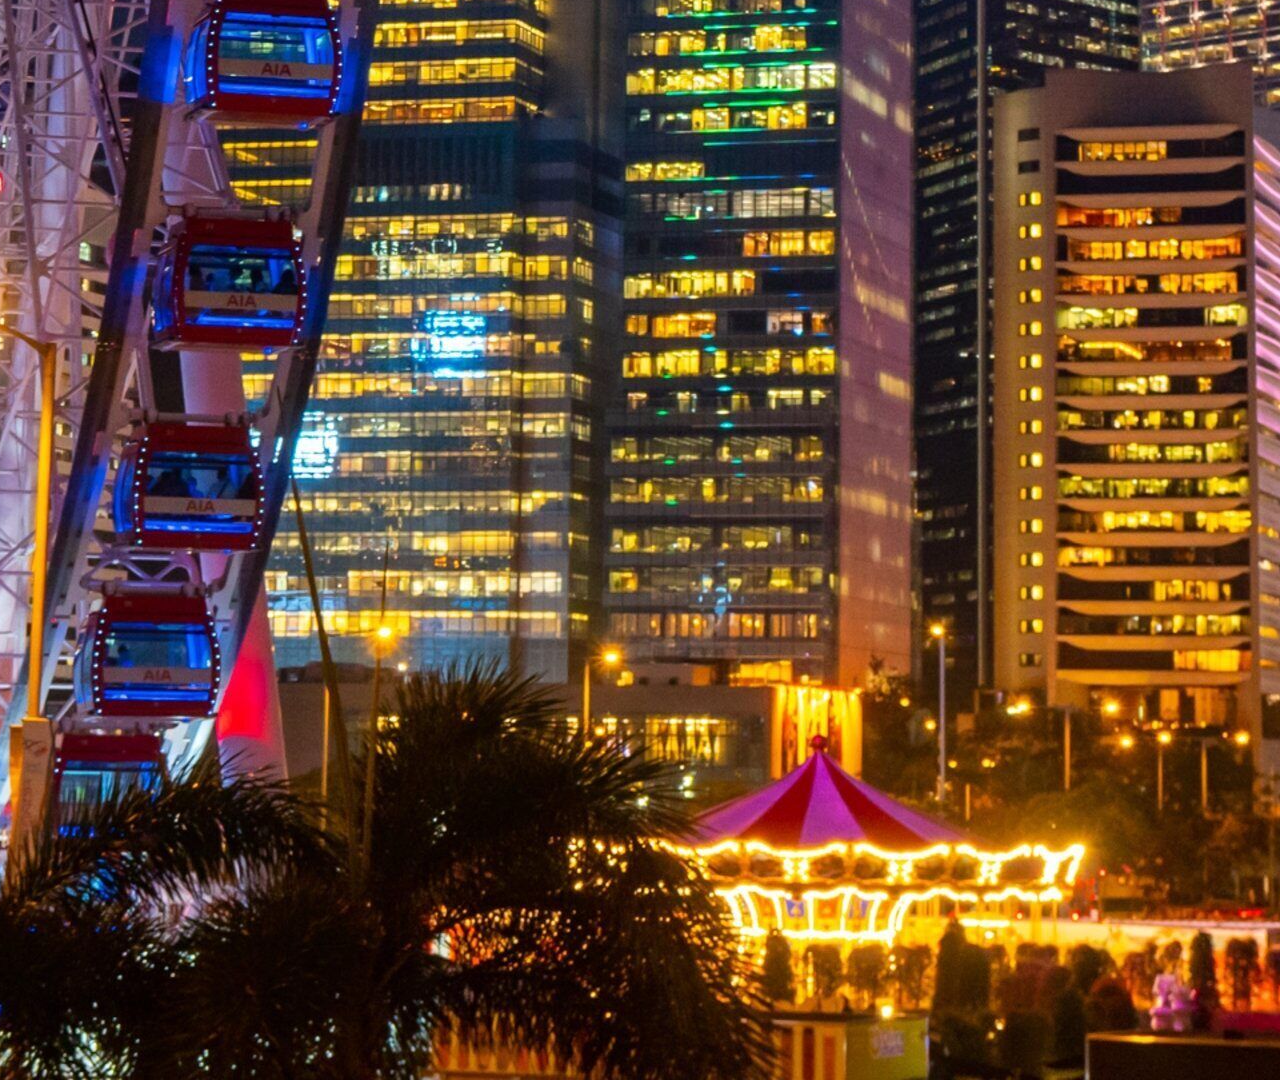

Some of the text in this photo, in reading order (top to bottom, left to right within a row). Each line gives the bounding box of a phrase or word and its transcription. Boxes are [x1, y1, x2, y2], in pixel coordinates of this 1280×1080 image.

[261, 62, 292, 77] AIA
[226, 295, 257, 308] AIA
[185, 500, 216, 513] AIA
[142, 669, 172, 681] AIA
